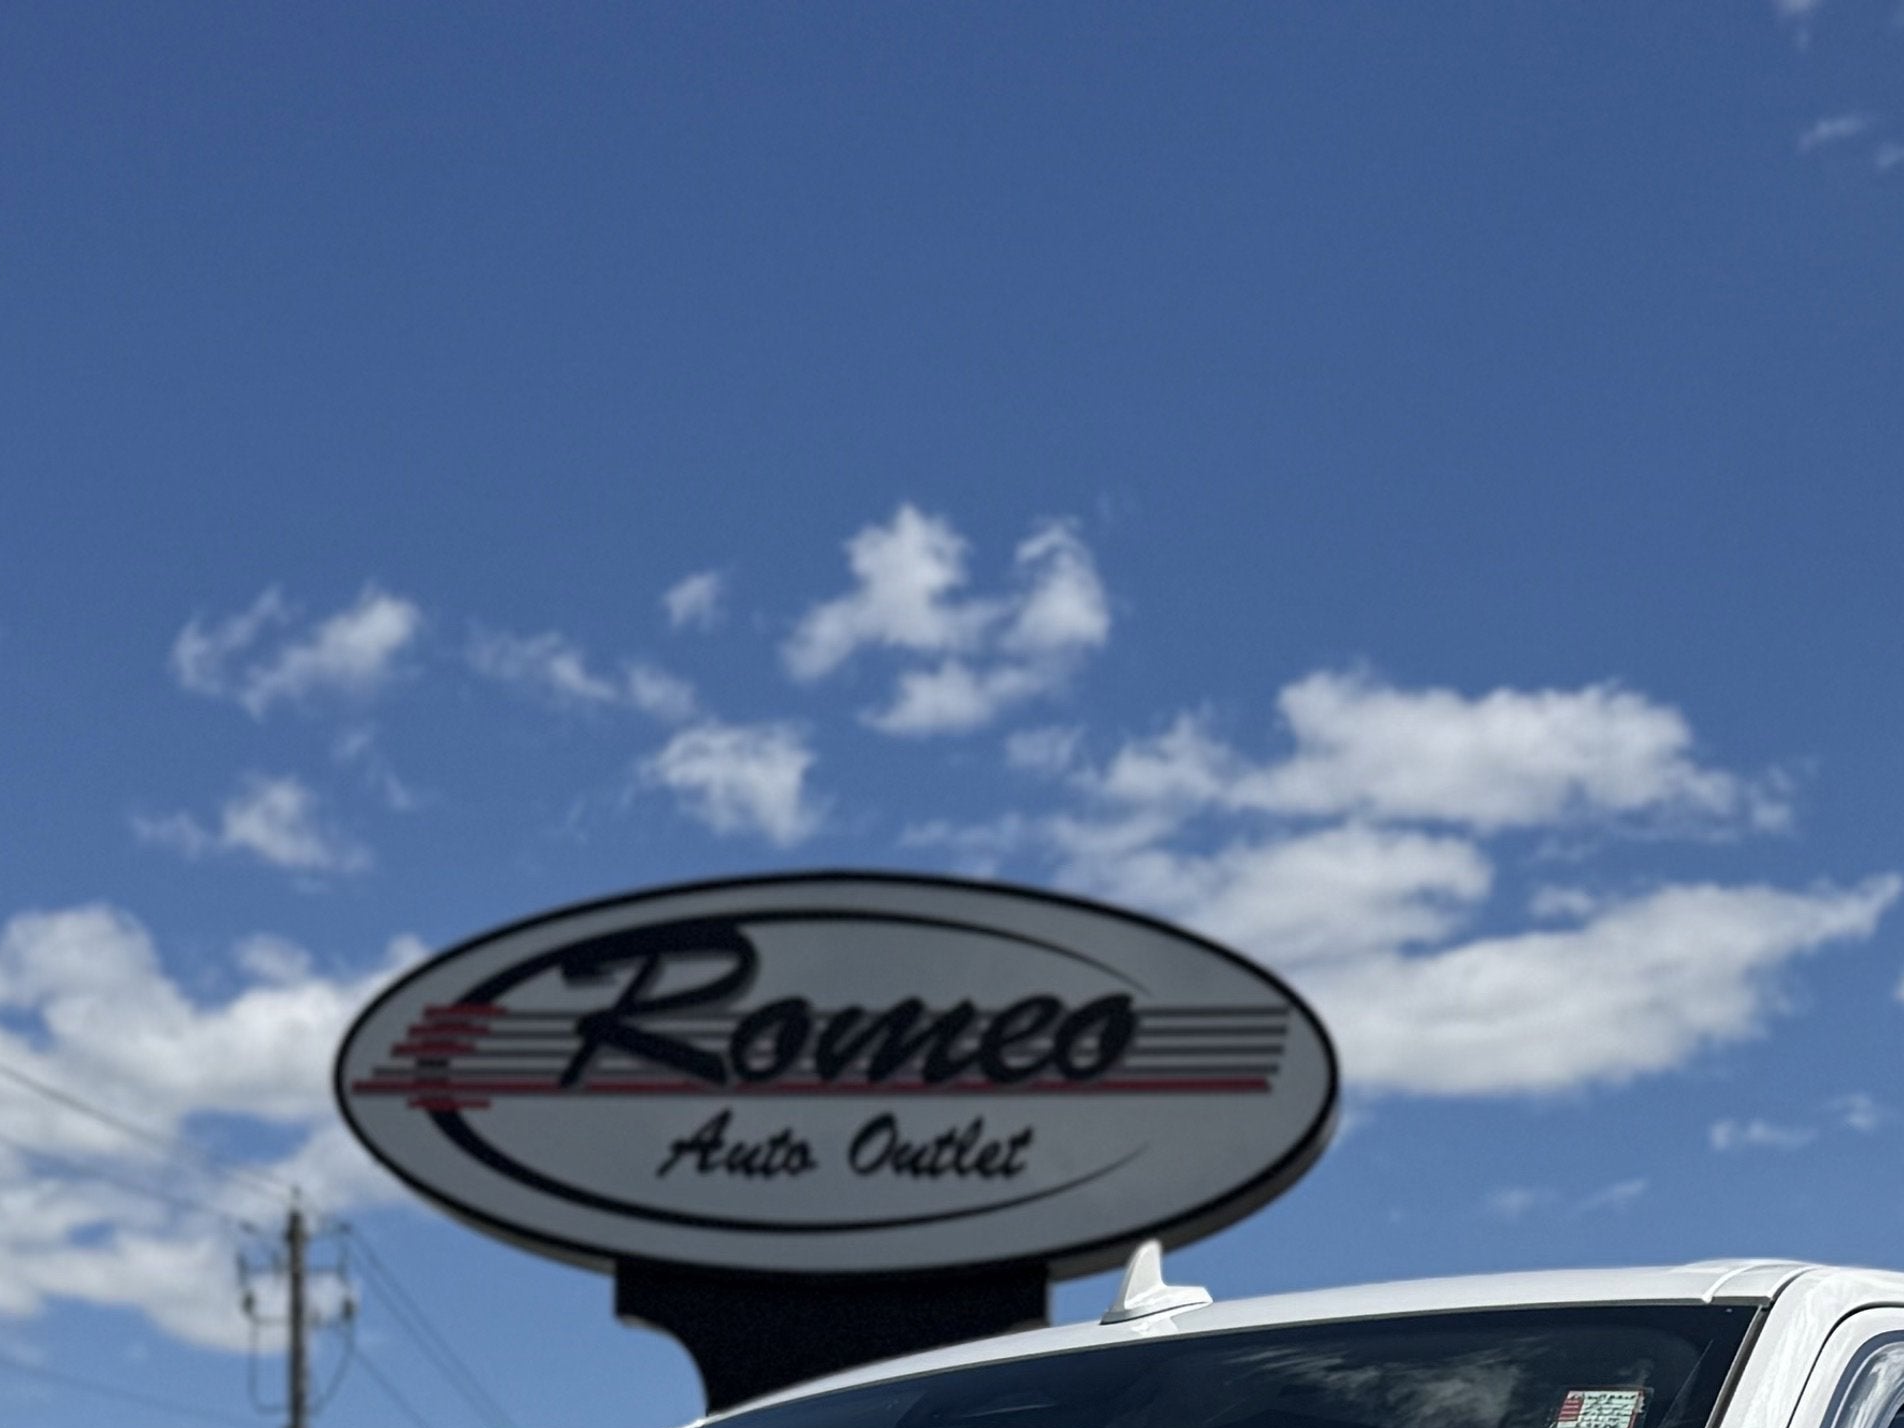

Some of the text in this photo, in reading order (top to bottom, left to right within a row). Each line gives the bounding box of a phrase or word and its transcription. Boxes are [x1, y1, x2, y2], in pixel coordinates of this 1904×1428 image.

[556, 919, 1138, 1087] Romeo
[657, 1108, 1035, 1178] Auto Outlet
